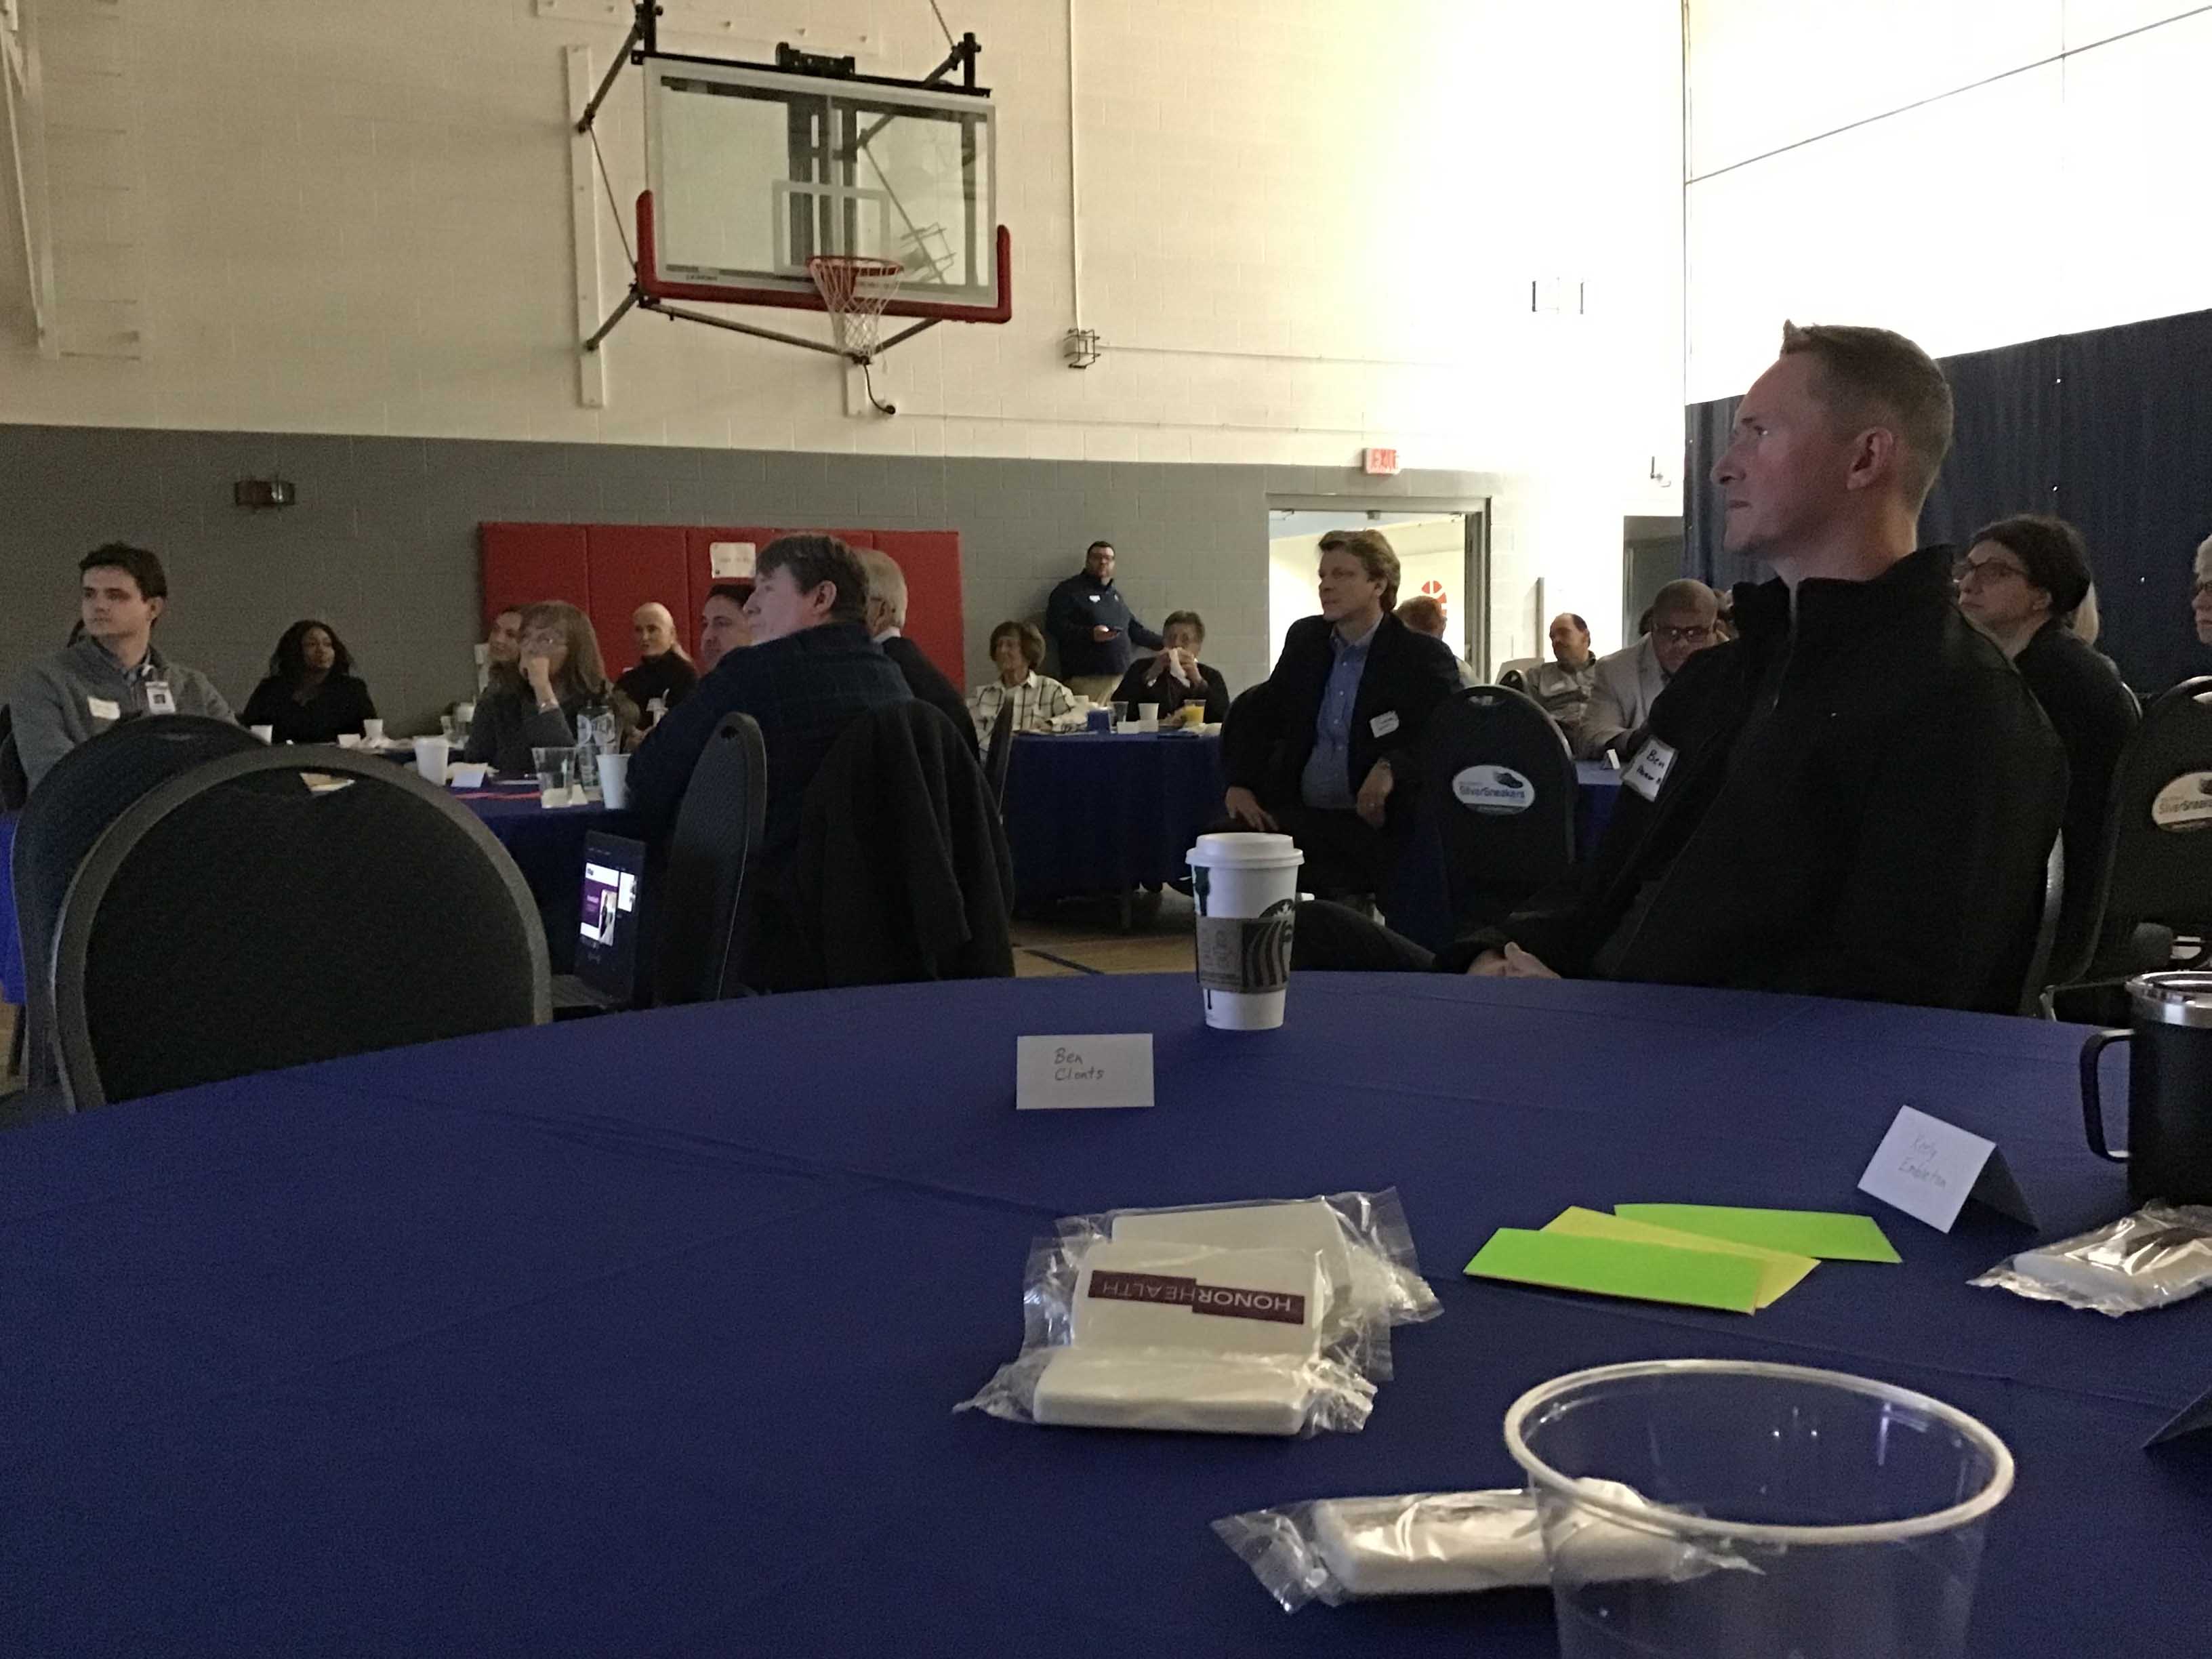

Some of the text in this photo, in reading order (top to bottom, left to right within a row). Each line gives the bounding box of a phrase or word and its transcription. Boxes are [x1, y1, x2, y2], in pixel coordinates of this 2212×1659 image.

[1459, 785, 1525, 798] SilverSneakers
[1054, 1047, 1084, 1065] Ben
[1103, 1281, 1291, 1312] HONORHEALTH
